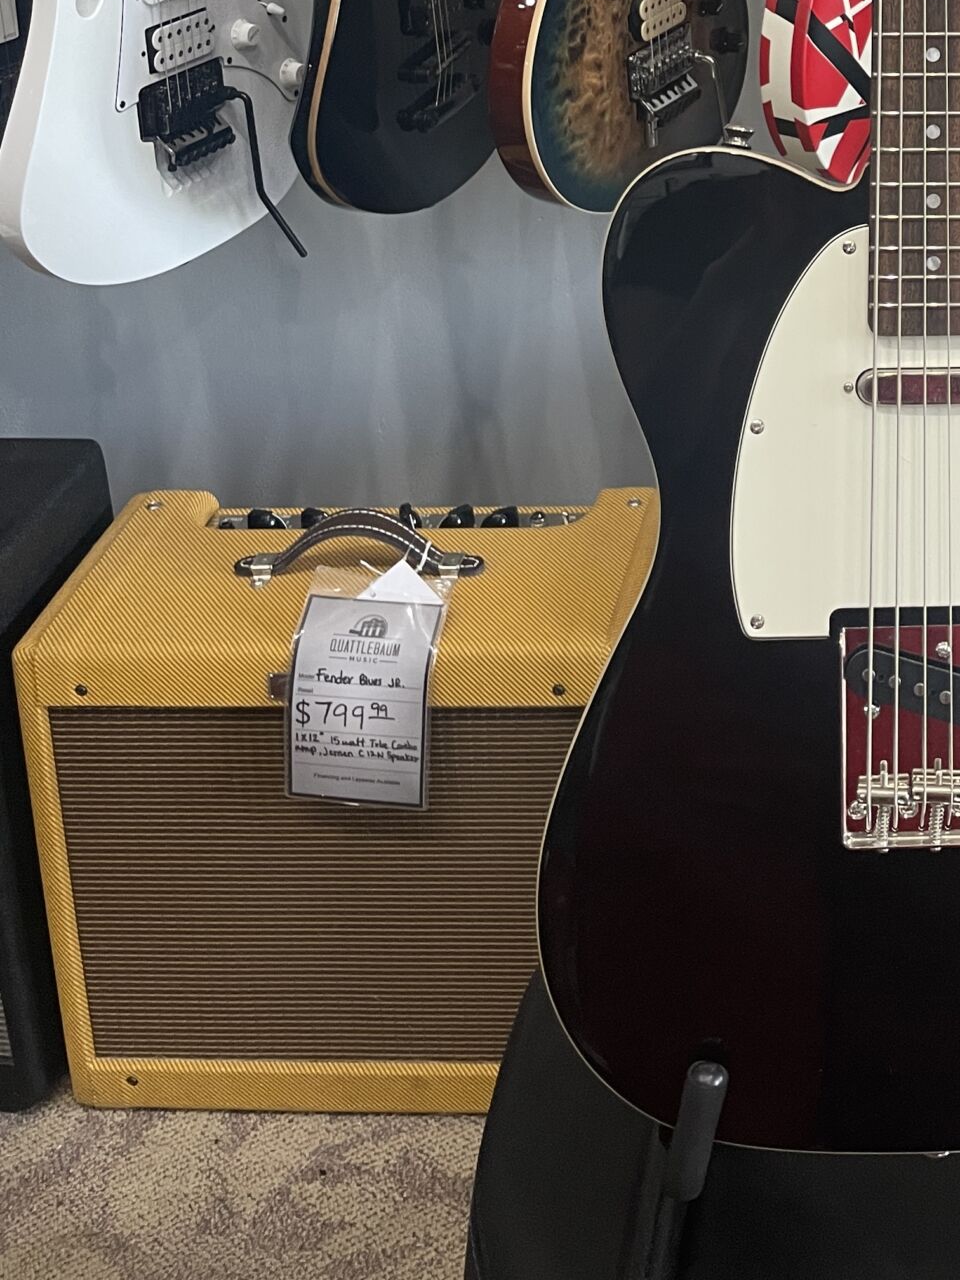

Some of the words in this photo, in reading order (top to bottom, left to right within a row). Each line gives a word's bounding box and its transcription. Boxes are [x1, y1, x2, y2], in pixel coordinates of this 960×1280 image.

[329, 637, 401, 658] QUATTLEBAUM
[348, 655, 379, 665] MUSIC
[316, 667, 354, 686] Fender
[358, 673, 383, 687] Blues
